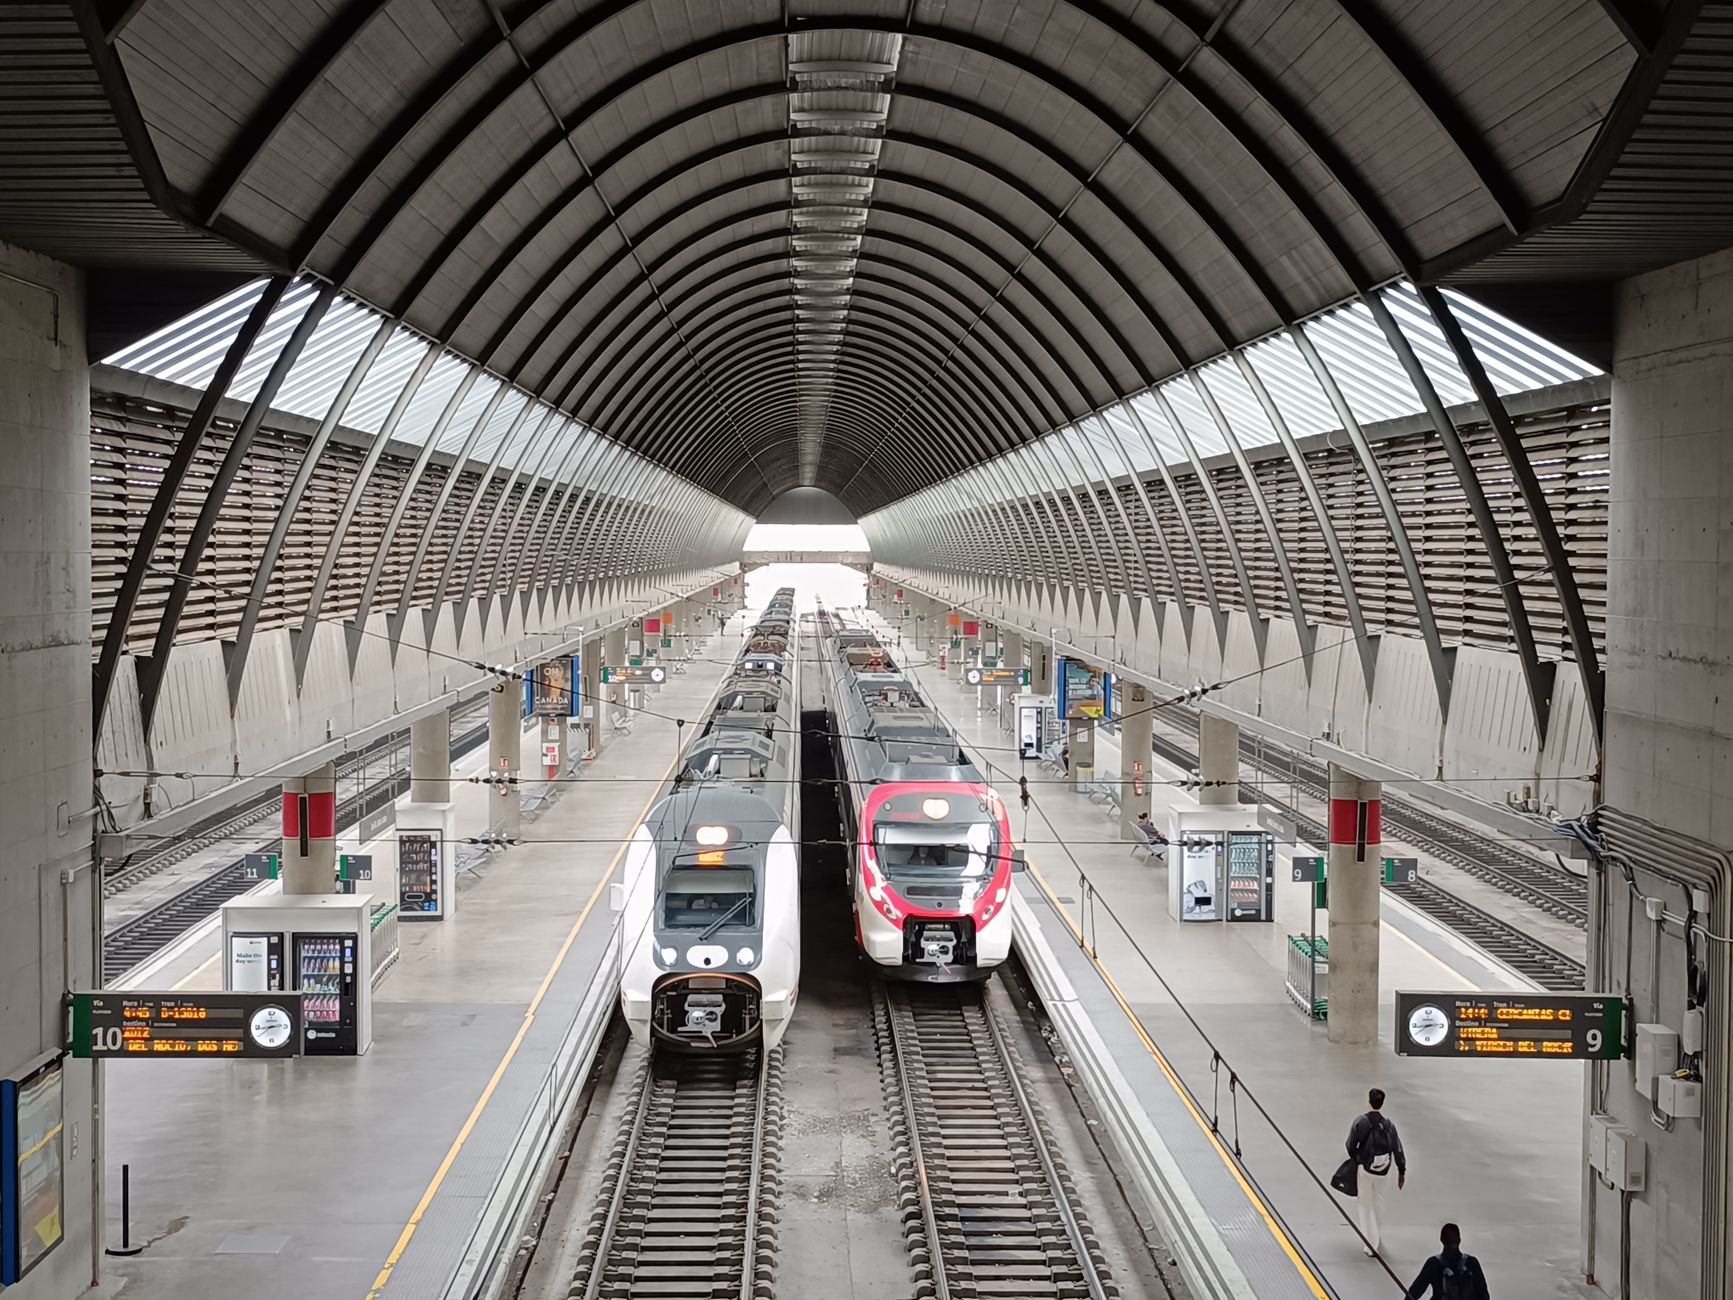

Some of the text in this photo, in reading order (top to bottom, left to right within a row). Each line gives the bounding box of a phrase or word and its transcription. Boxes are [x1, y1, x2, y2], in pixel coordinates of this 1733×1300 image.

[246, 868, 258, 878] 11
[359, 870, 371, 880] 10
[1294, 869, 1302, 880] 9
[1408, 870, 1416, 882] 8
[92, 1027, 122, 1050] 10
[1586, 1028, 1603, 1052] 9
[1518, 1041, 1537, 1052] DEL
